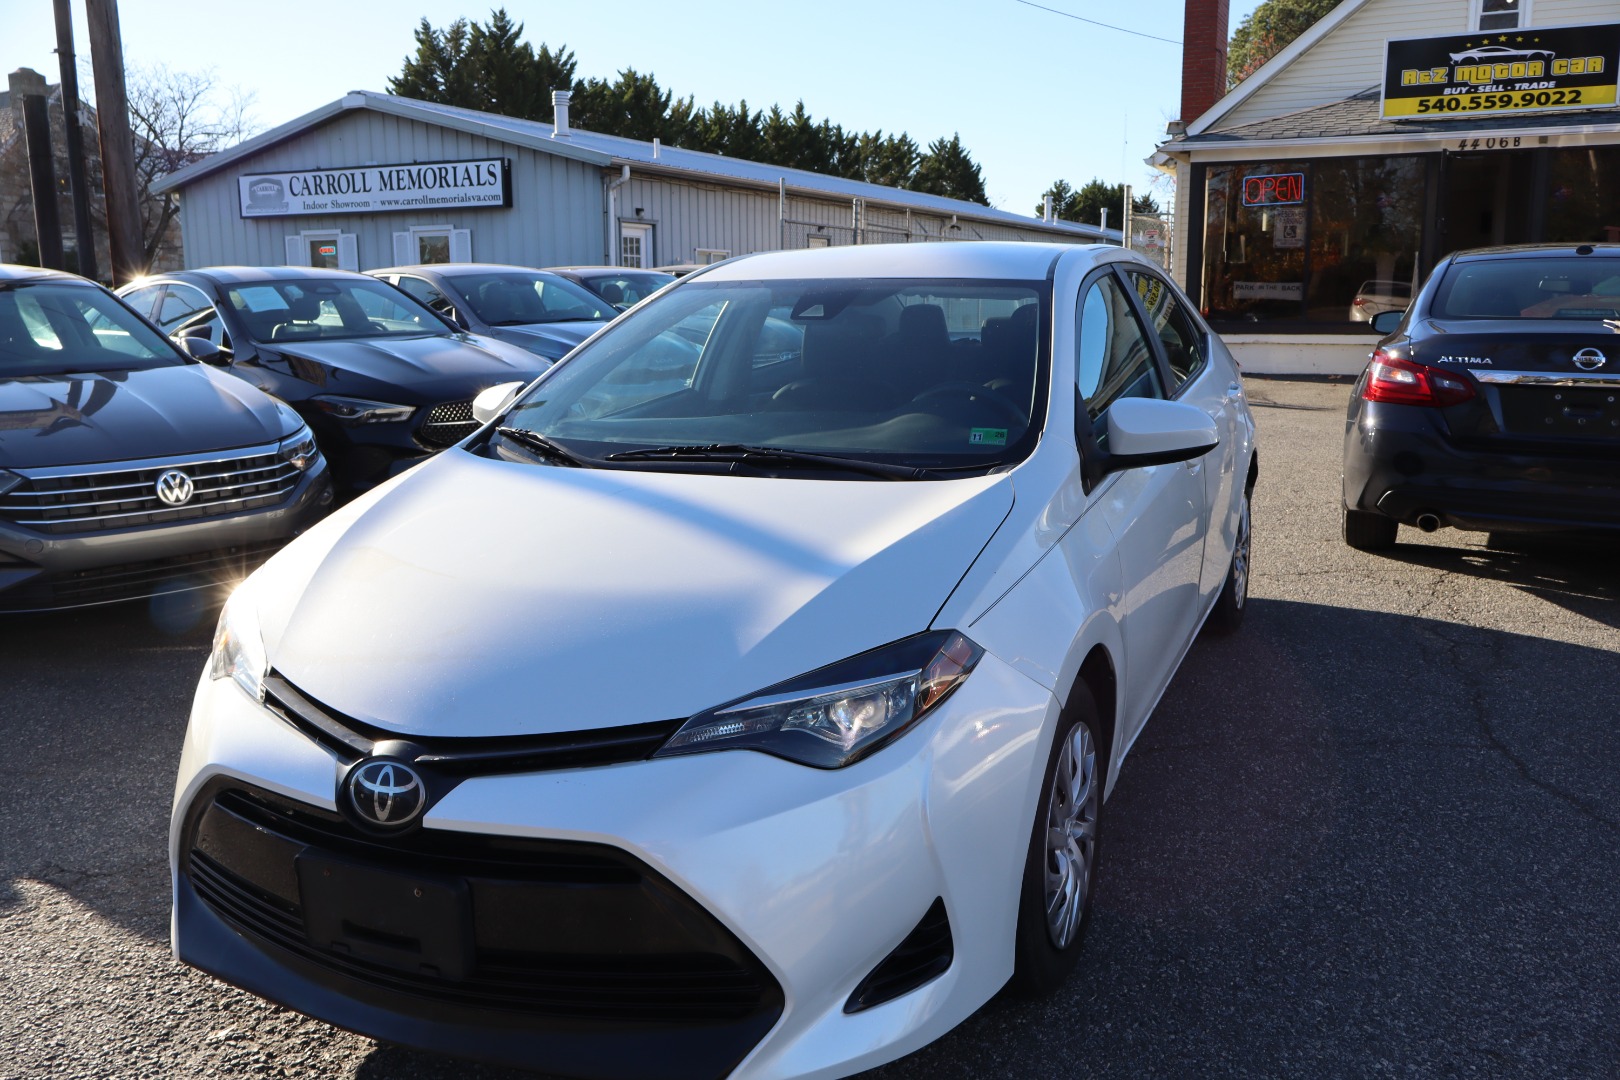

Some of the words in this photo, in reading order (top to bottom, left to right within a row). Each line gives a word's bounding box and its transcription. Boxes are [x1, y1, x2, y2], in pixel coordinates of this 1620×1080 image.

[1443, 86, 1470, 96] BUY
[1477, 84, 1505, 94] SELL
[1514, 81, 1556, 92] TRADE
[1417, 90, 1582, 113] 540.559.9022
[289, 172, 373, 198] CARROLL
[378, 163, 498, 193] MEMORIALS
[1245, 176, 1302, 203] OPEN
[302, 201, 328, 211] Indoor
[330, 199, 371, 209] Showroom
[379, 193, 501, 207] www.carrollmemorialsva.com
[1438, 355, 1493, 365] ALTIMA
